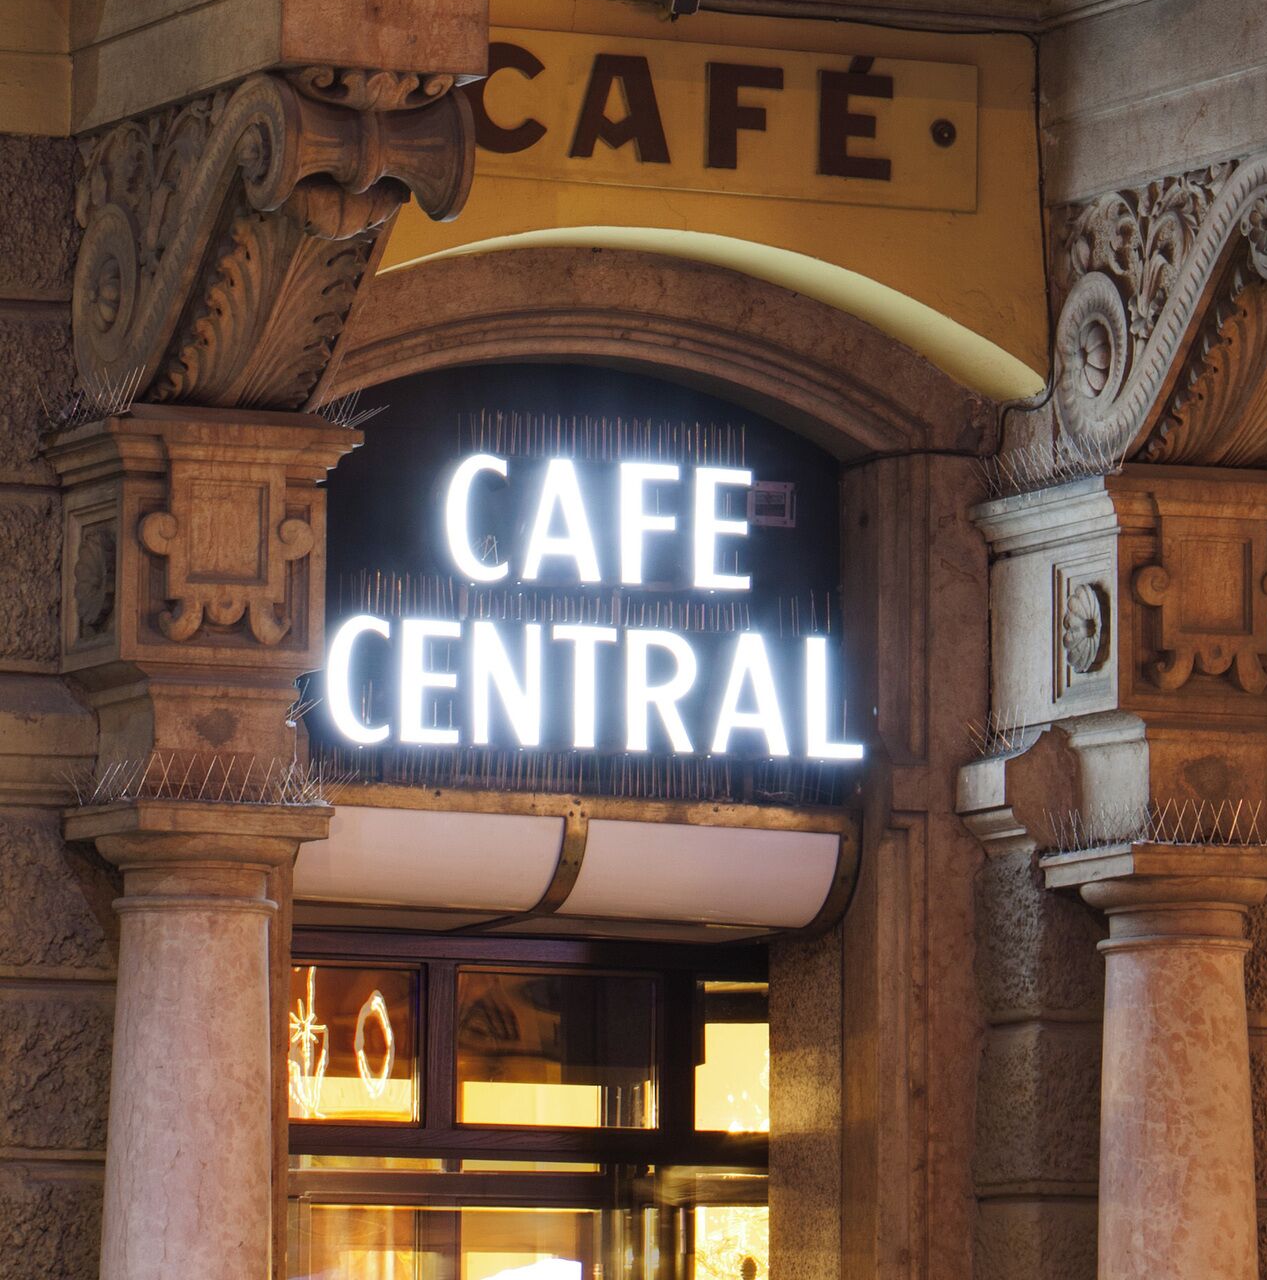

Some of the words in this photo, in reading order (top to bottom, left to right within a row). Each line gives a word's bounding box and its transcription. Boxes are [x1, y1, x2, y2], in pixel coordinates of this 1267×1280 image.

[473, 41, 894, 182] CAFÉ
[444, 453, 753, 591] CAFE
[326, 614, 864, 760] CENTRAL
